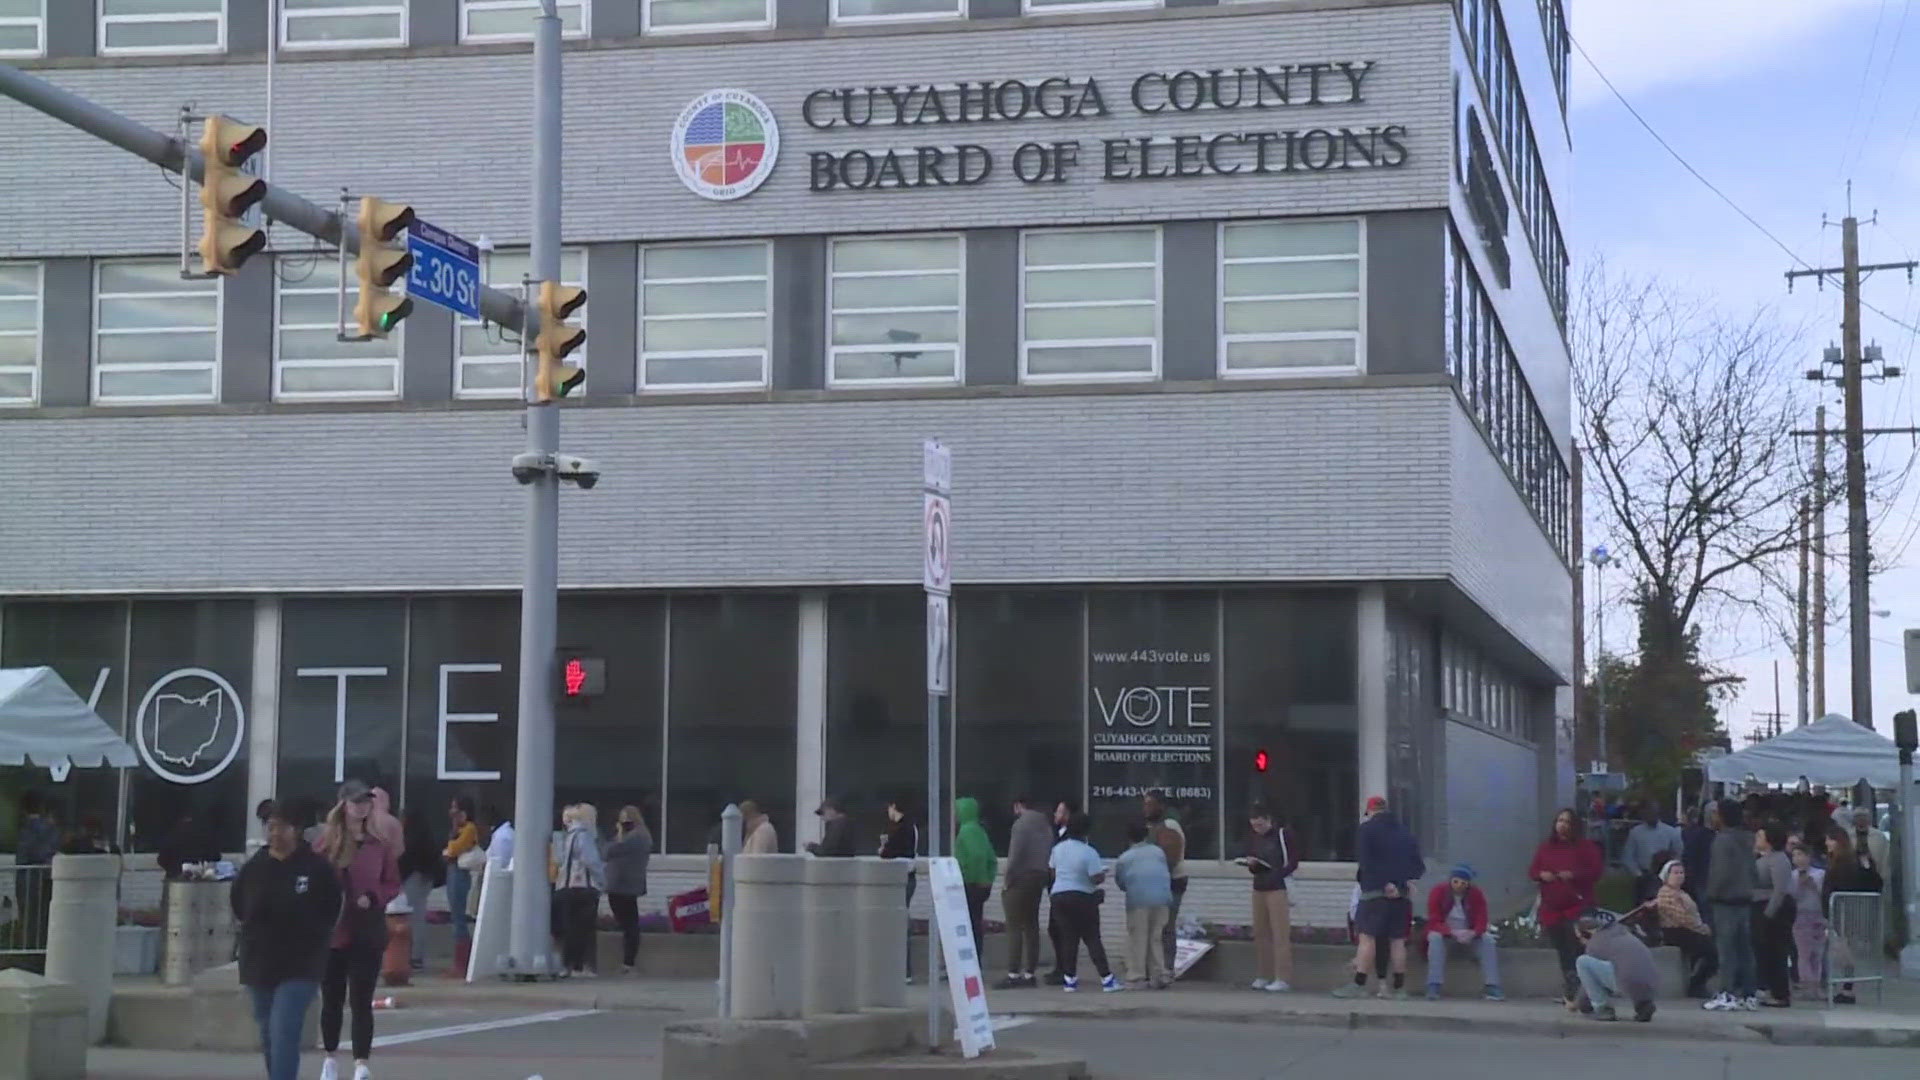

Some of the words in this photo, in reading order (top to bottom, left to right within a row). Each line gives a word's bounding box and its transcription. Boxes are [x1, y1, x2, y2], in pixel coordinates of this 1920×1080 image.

[802, 76, 1111, 129] CUYAHOGA
[1131, 60, 1376, 115] COUNTY
[807, 144, 993, 192] BOARD
[1012, 140, 1081, 184] OF
[1102, 125, 1409, 181] ELECTIONS
[412, 248, 427, 289] E.
[430, 257, 455, 299] 30
[456, 269, 477, 310] St
[1093, 650, 1211, 663] www.443vote.us
[1093, 686, 1211, 727] VOTE
[1093, 733, 1158, 745] CUYAHOGA
[1161, 733, 1211, 745] COUNTY
[1093, 752, 1131, 762] BOARD
[1132, 753, 1148, 762] OF
[1150, 753, 1211, 763] ELECTIONS
[1093, 786, 1173, 798] 216-443-VE
